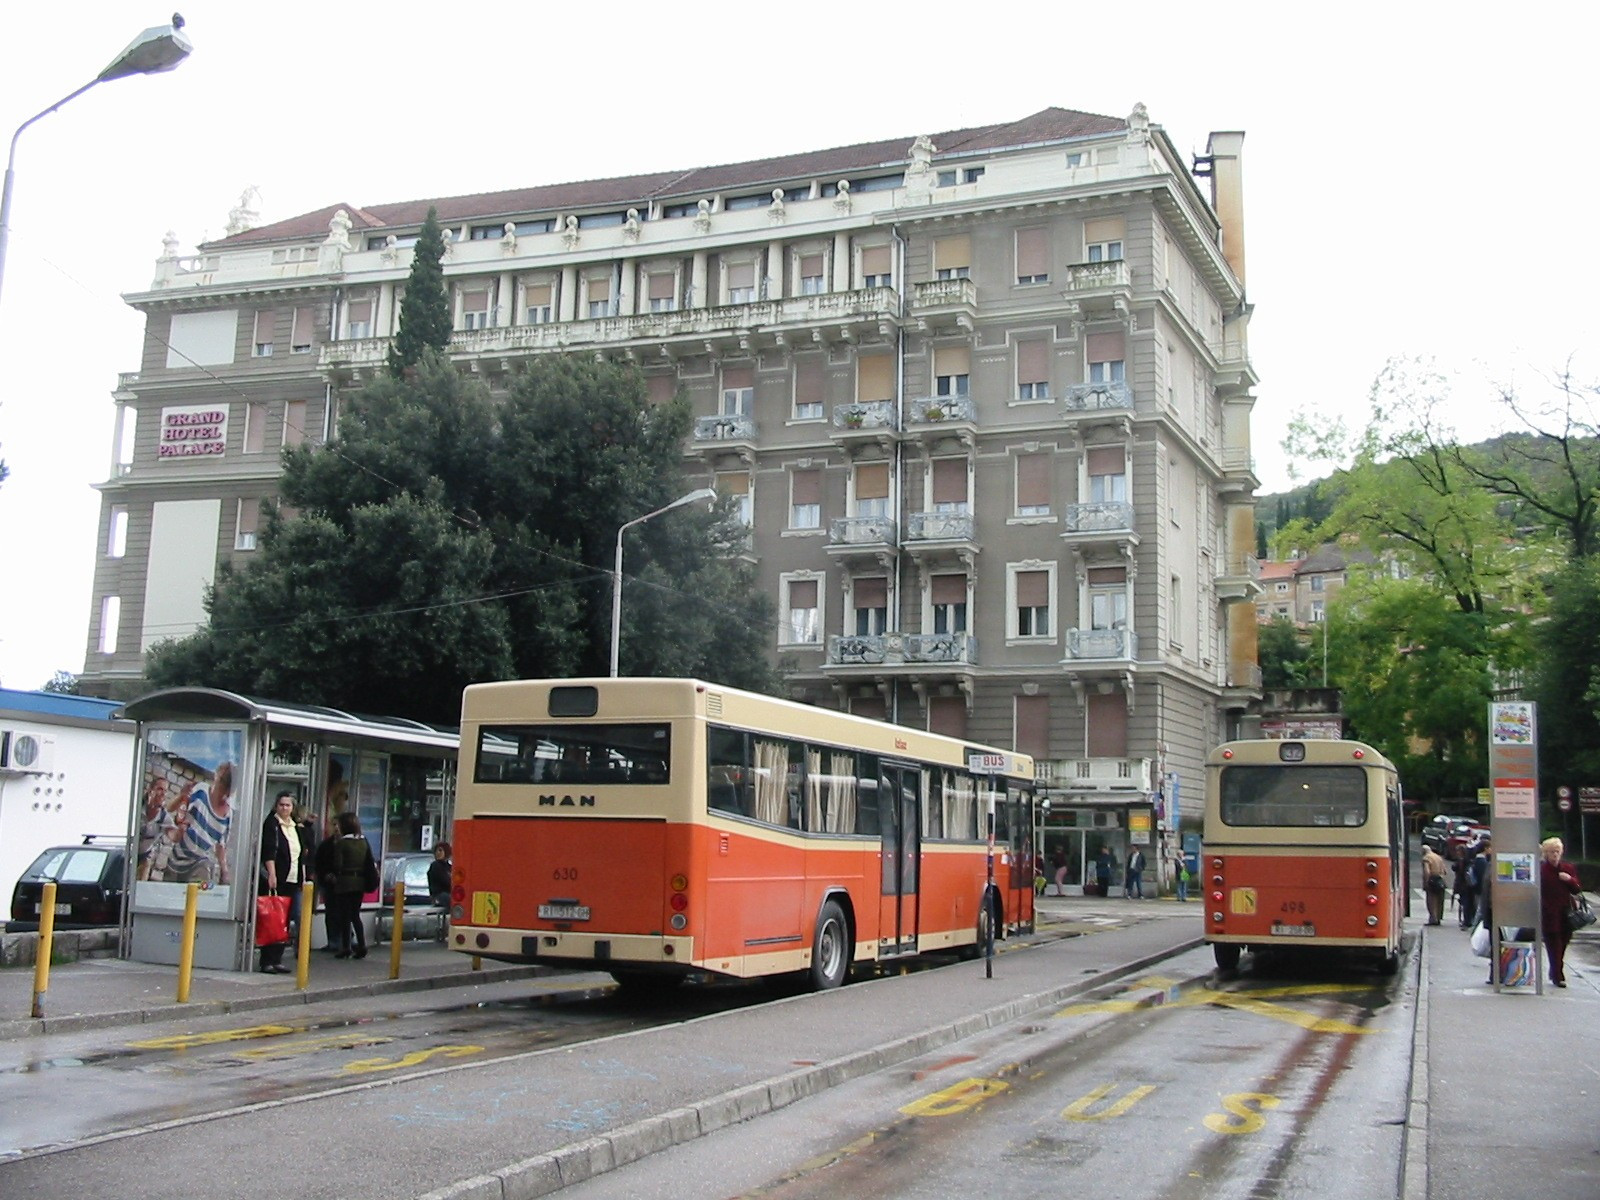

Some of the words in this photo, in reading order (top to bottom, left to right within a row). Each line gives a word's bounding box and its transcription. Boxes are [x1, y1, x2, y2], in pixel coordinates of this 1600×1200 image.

[165, 411, 225, 426] GRAND
[162, 426, 222, 441] HOTEL
[157, 441, 225, 457] PALACE
[983, 755, 1005, 766] BUS
[539, 794, 595, 806] MAN
[553, 867, 578, 880] 630
[1281, 900, 1306, 914] 498
[899, 1077, 1282, 1135] BUS
